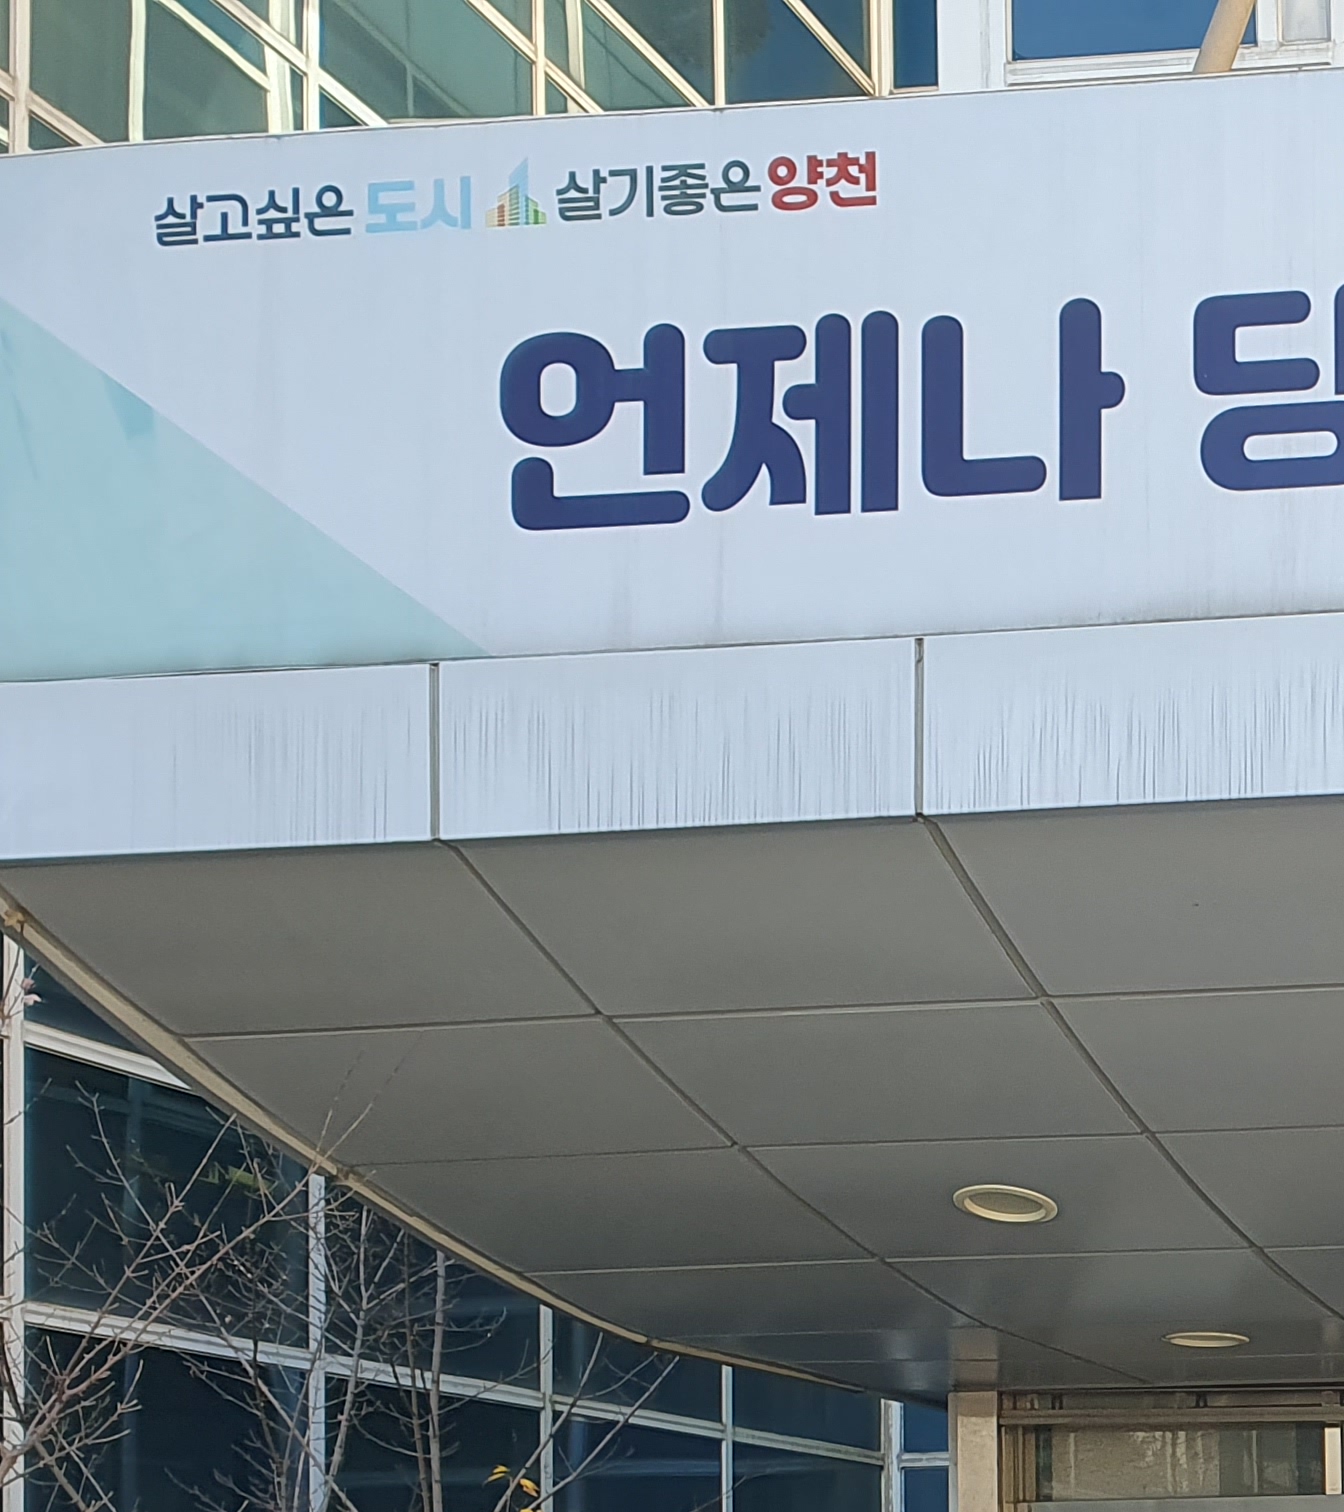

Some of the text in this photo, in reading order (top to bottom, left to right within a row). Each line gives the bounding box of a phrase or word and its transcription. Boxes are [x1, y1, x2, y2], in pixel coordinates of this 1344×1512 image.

[154, 151, 878, 247] 살고싶은 도시 살기좋은 양천
[498, 297, 1125, 531] 언제나
